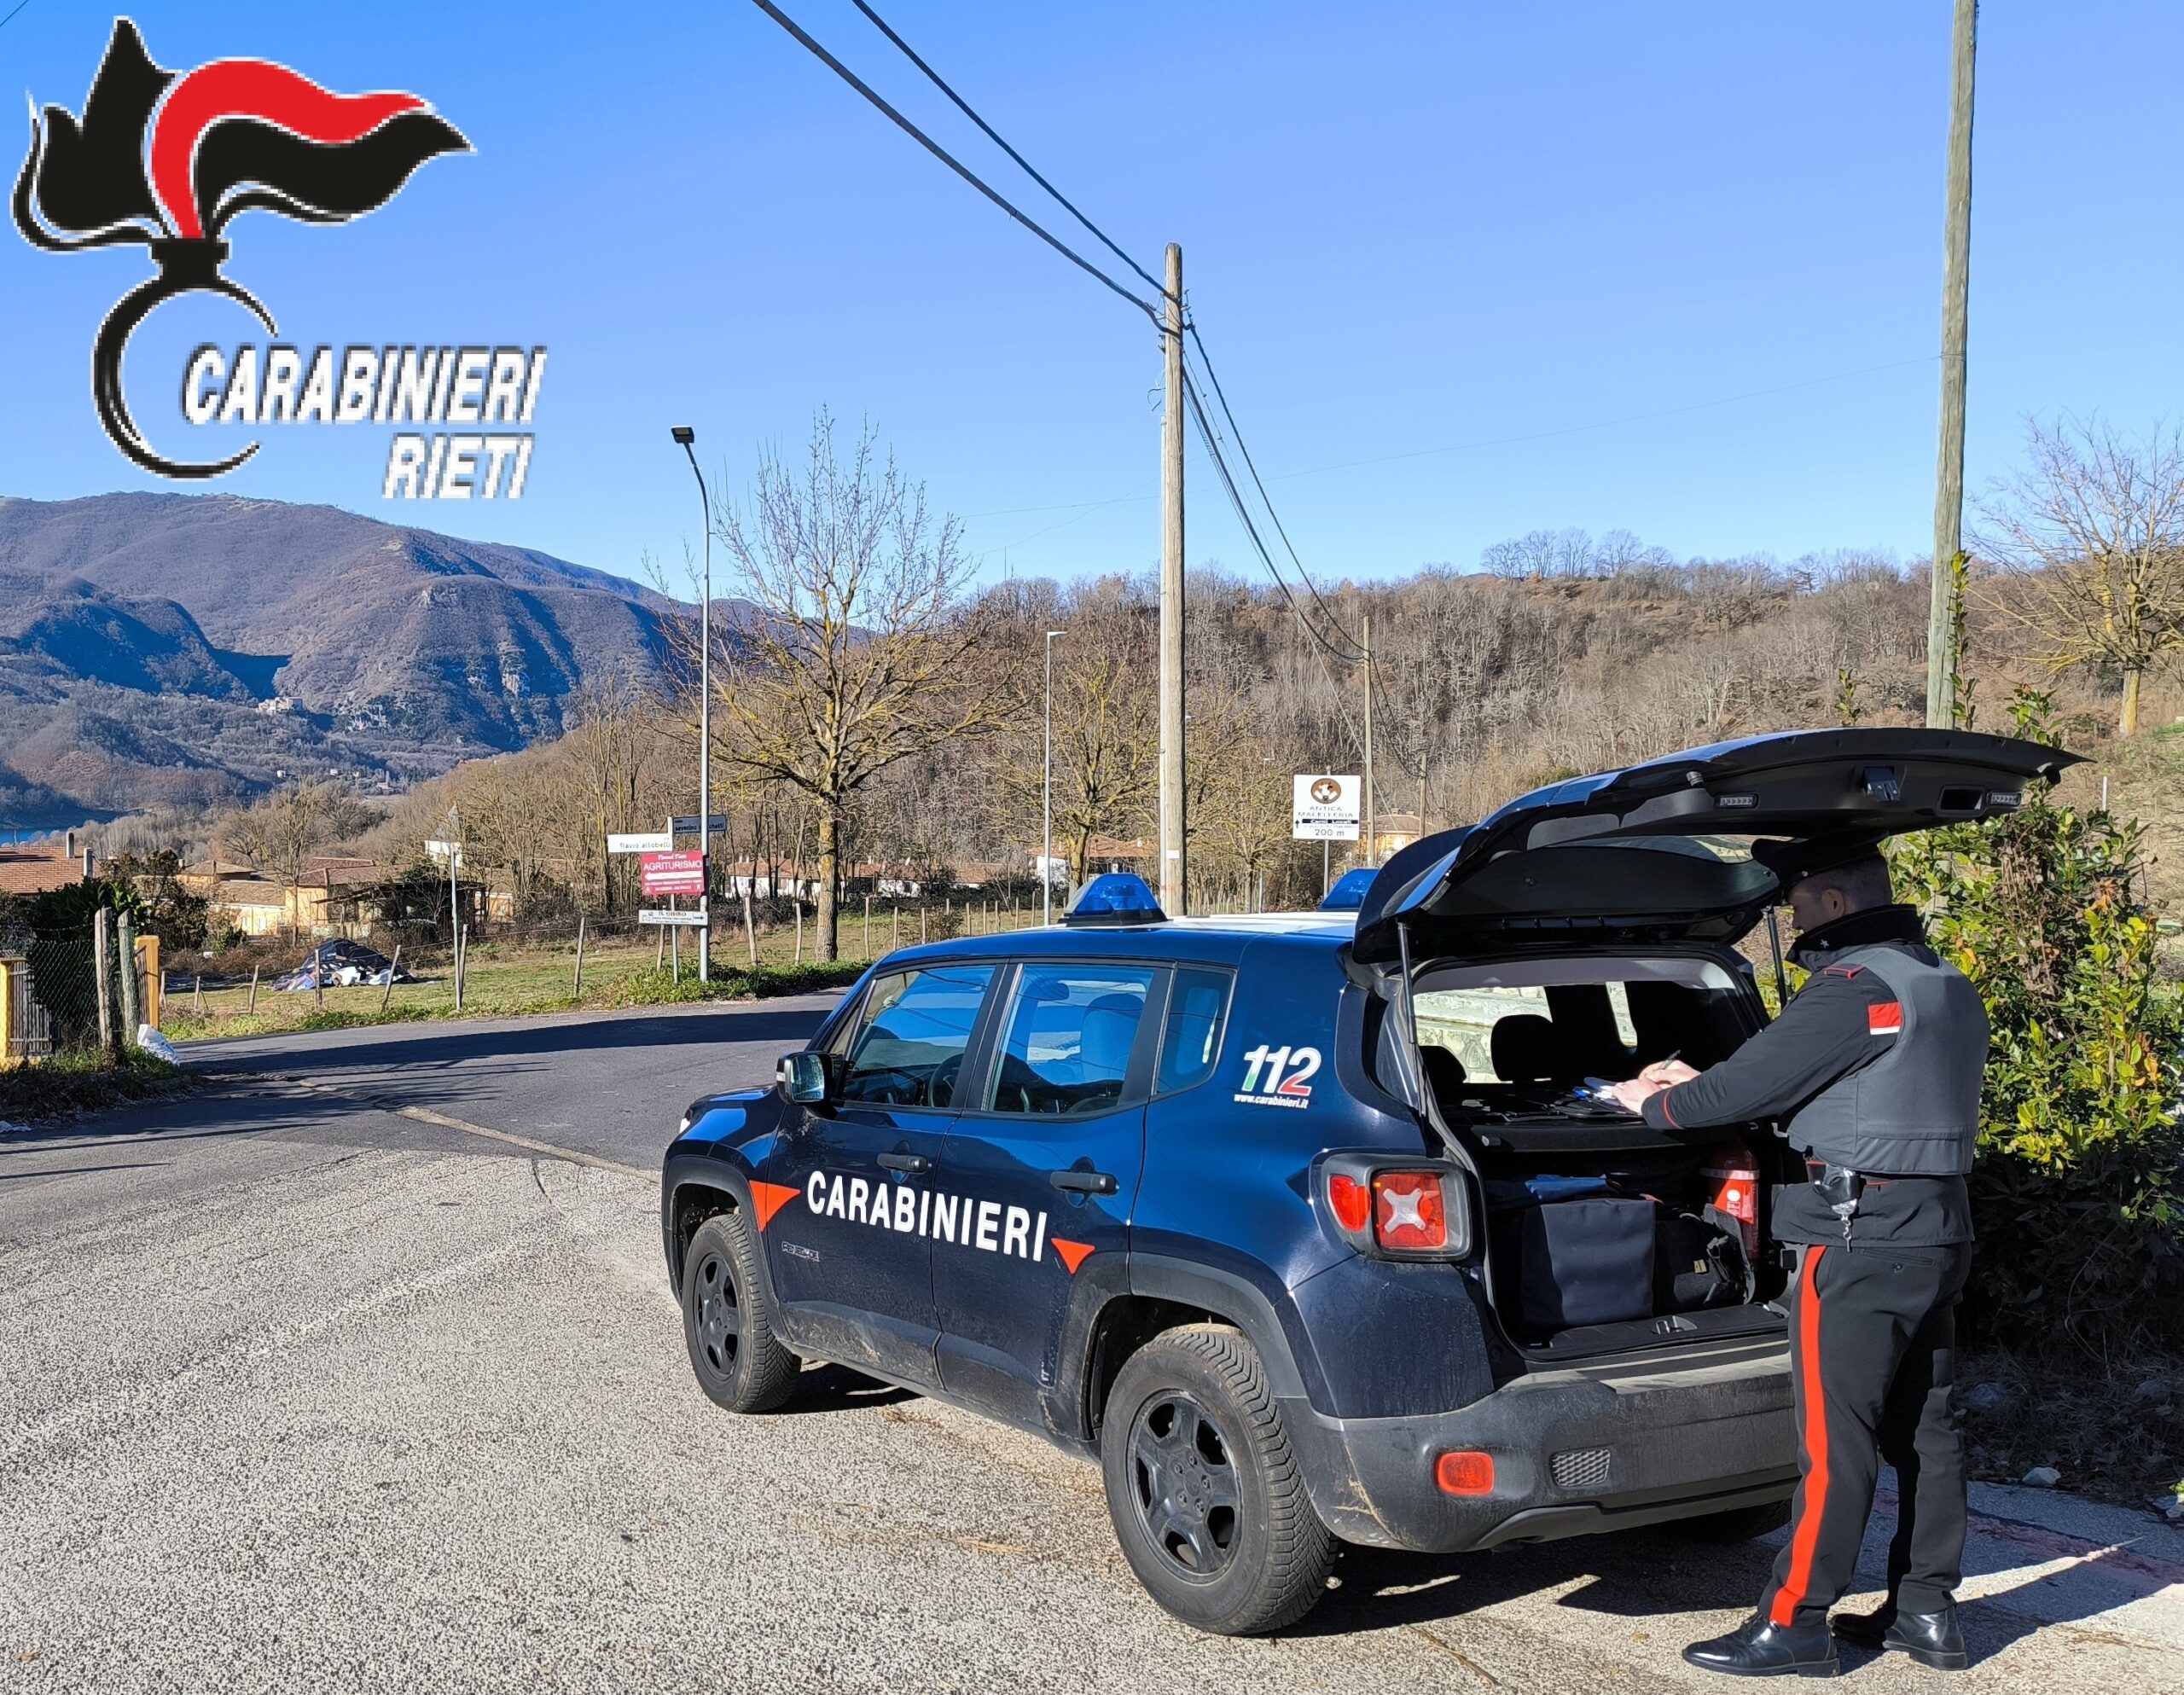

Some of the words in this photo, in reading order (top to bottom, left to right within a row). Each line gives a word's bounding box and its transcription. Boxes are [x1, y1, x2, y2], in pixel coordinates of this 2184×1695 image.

[643, 860, 702, 871] AGRITURISMO
[1241, 1044, 1321, 1096] 112
[1234, 1094, 1310, 1109] www.carabinieri.it
[806, 1170, 1048, 1263] CARABINIERI
